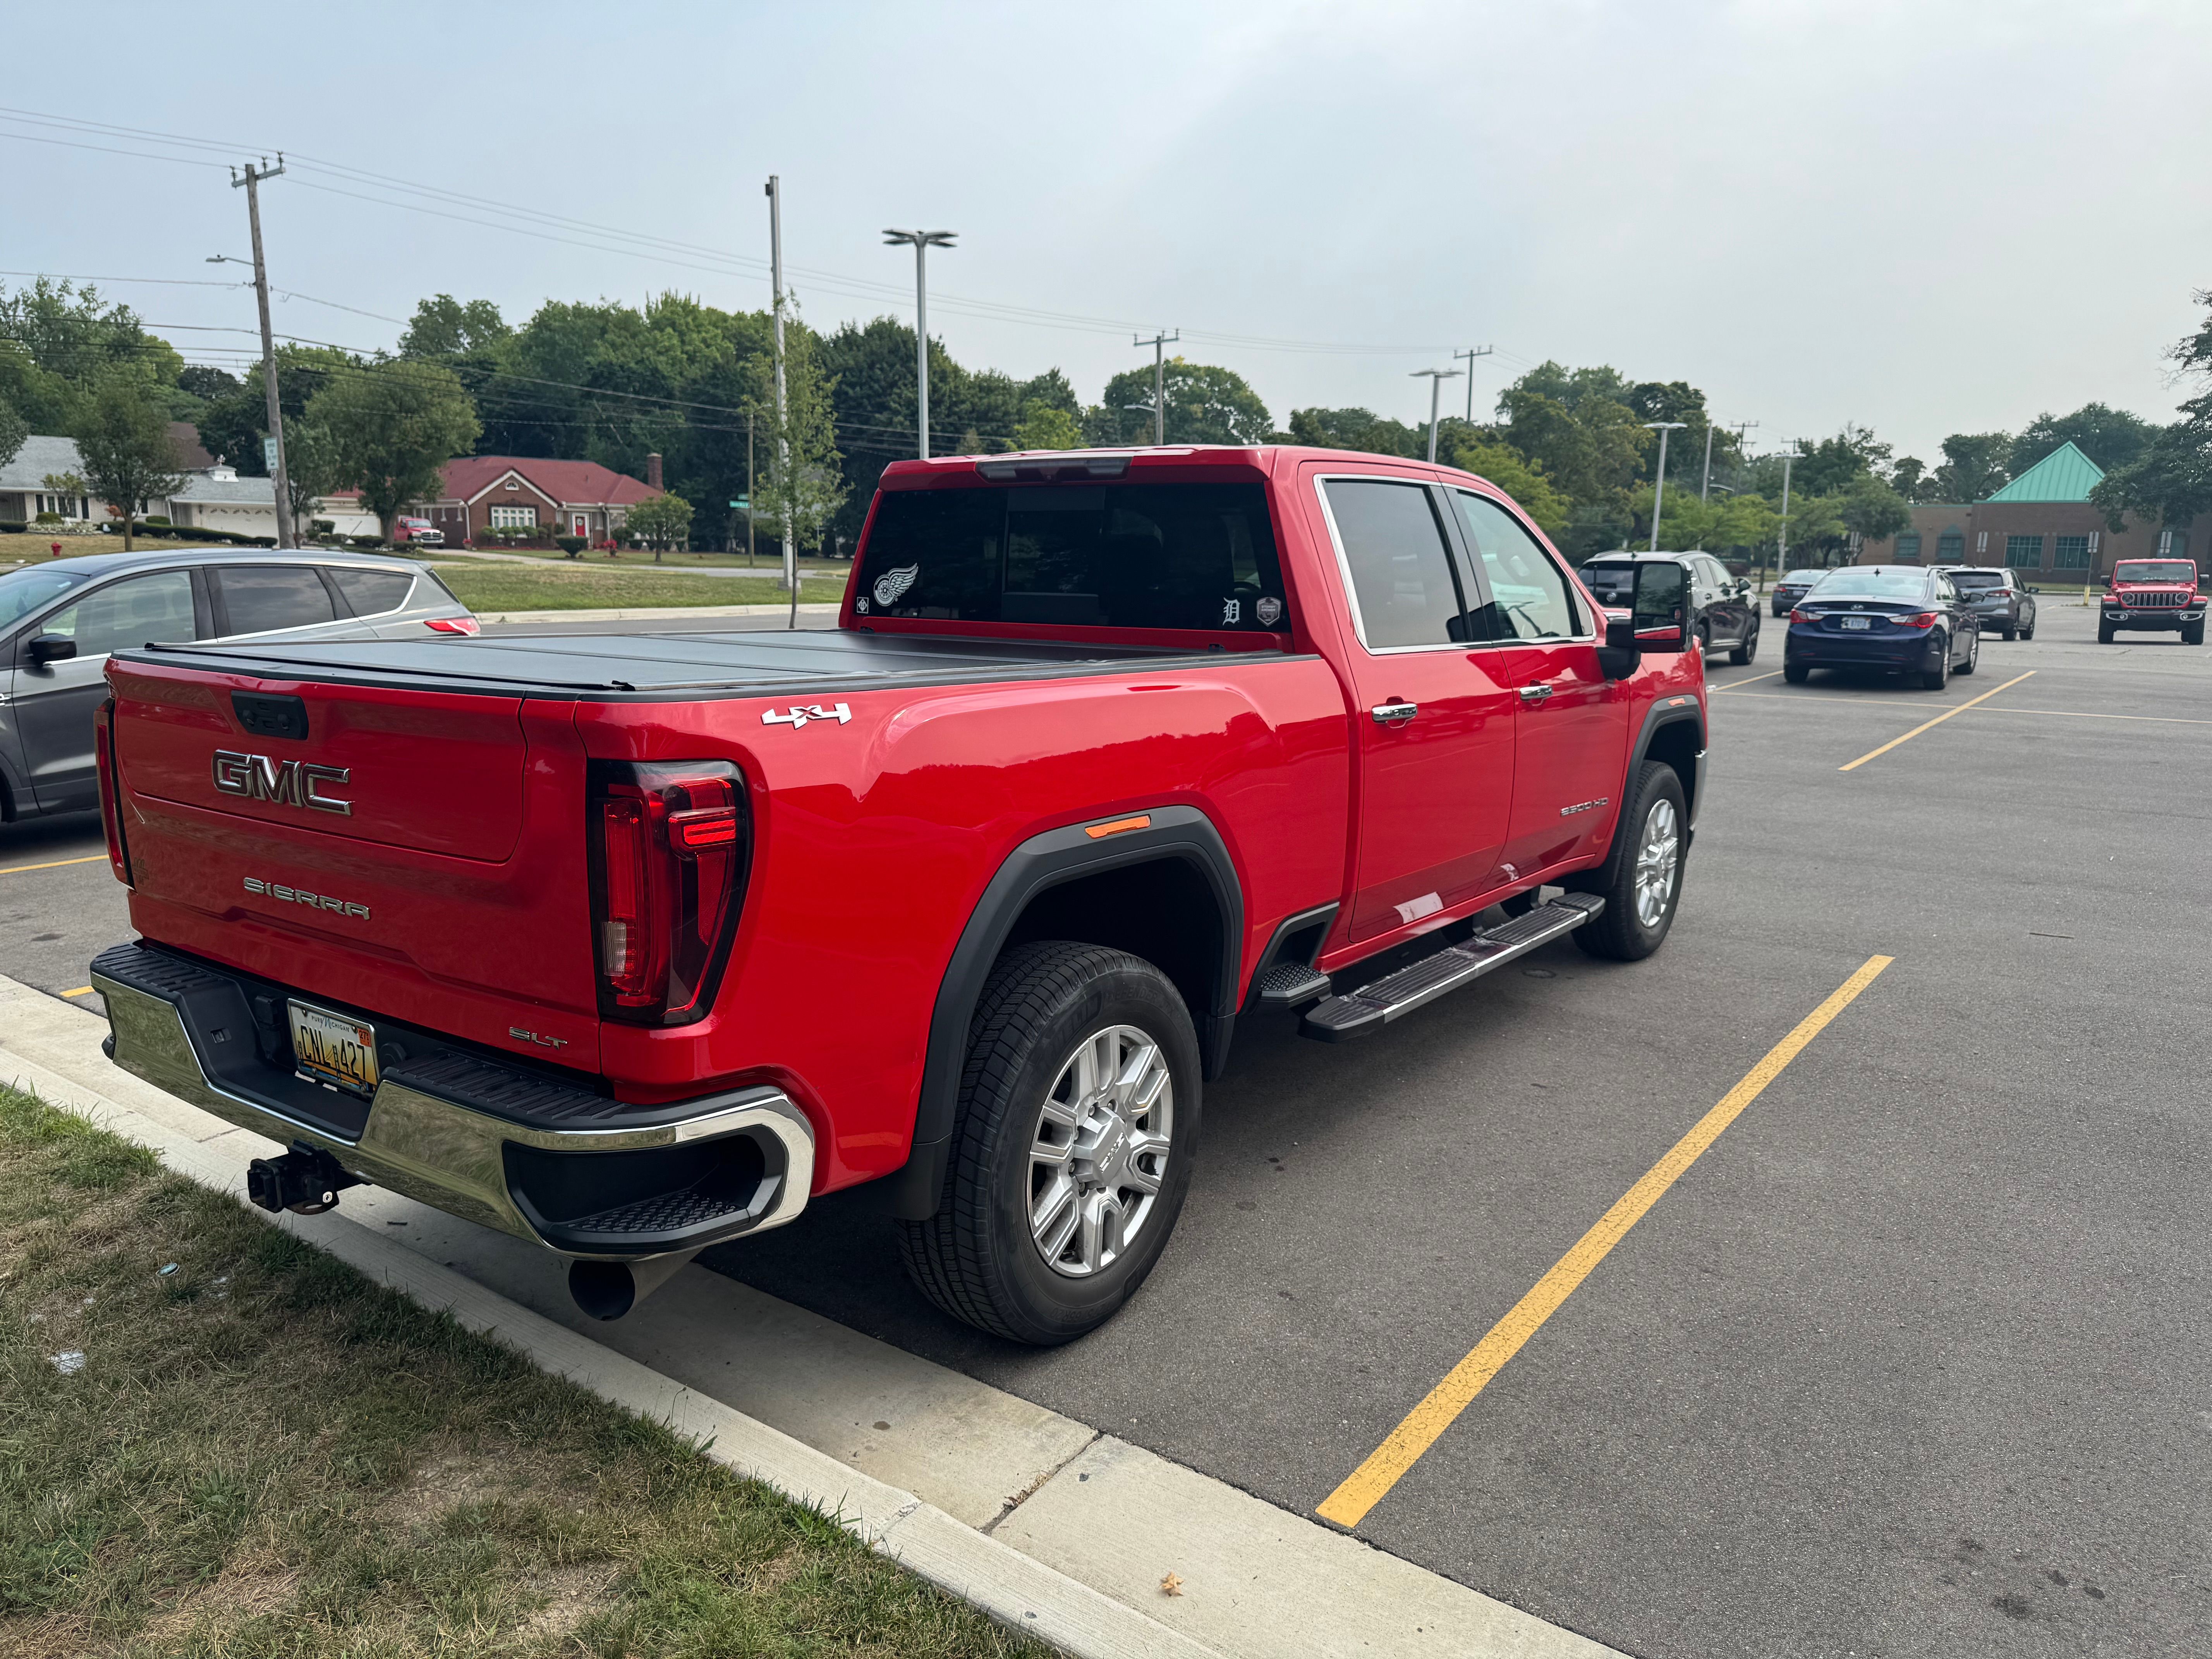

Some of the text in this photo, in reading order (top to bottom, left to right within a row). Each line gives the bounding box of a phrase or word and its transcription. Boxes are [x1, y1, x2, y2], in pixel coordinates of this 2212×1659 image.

[212, 749, 352, 816] GMC
[244, 877, 371, 921] SIERRA
[311, 1015, 323, 1024] PURE
[509, 1027, 568, 1050] SLT
[301, 1025, 366, 1080] CNL 427
[1099, 1132, 1125, 1173] GMC
